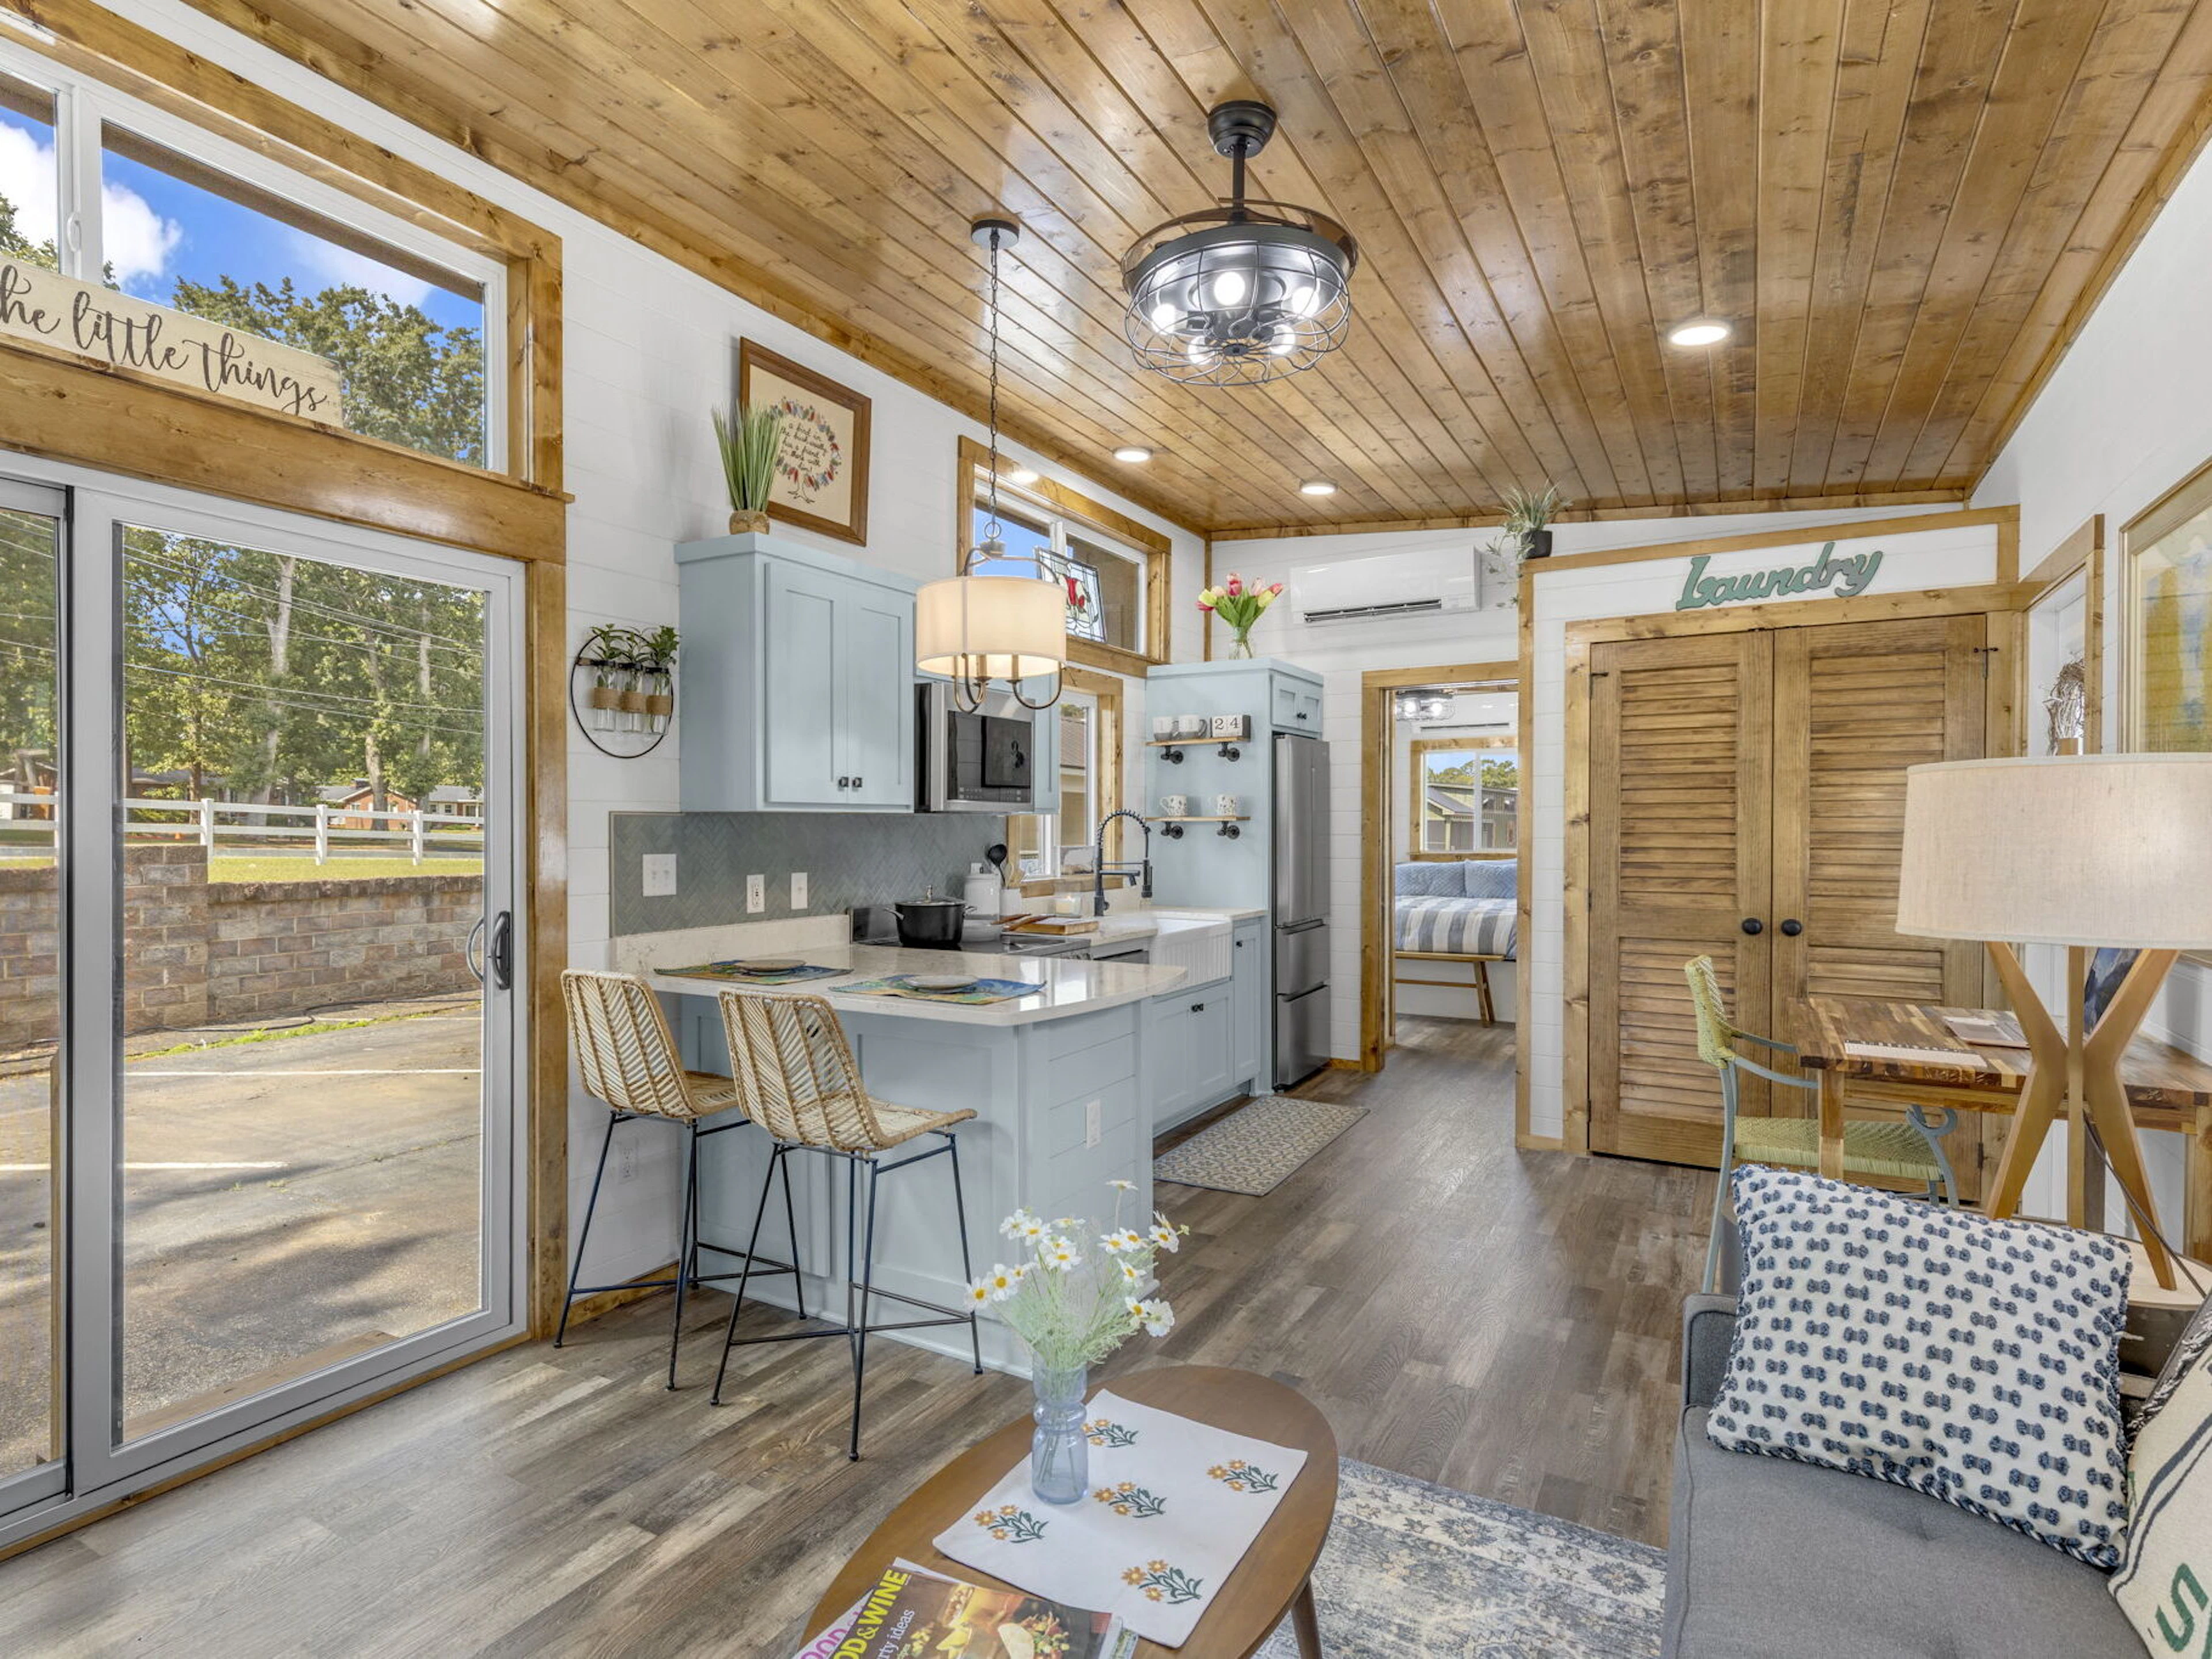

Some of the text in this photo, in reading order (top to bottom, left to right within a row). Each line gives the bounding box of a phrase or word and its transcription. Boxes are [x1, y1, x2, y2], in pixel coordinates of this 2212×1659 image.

[73, 291, 189, 369] little
[183, 332, 327, 416] things
[1675, 541, 1884, 611] Laundry
[887, 1609, 915, 1639] ideas
